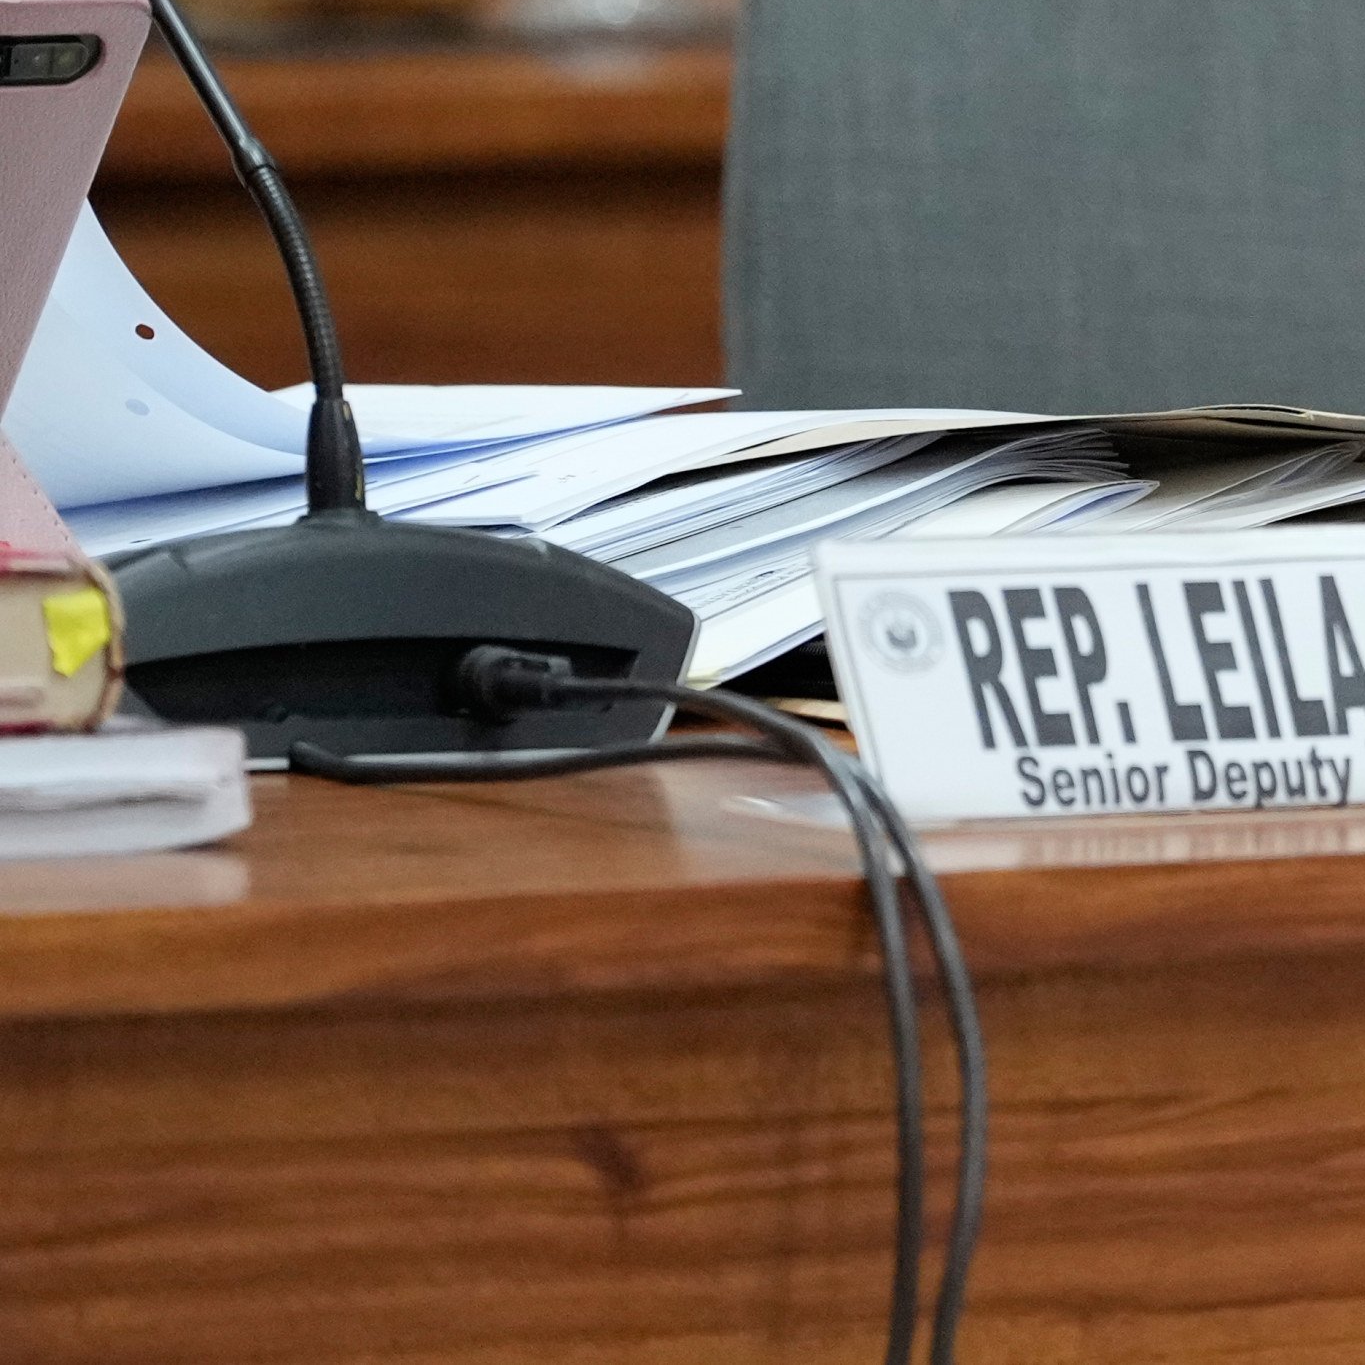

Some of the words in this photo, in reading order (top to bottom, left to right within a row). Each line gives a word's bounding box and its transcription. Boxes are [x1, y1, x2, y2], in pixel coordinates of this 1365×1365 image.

[948, 587, 1137, 749] REP.
[1016, 751, 1169, 808] Senior
[1186, 746, 1350, 809] Deputy
